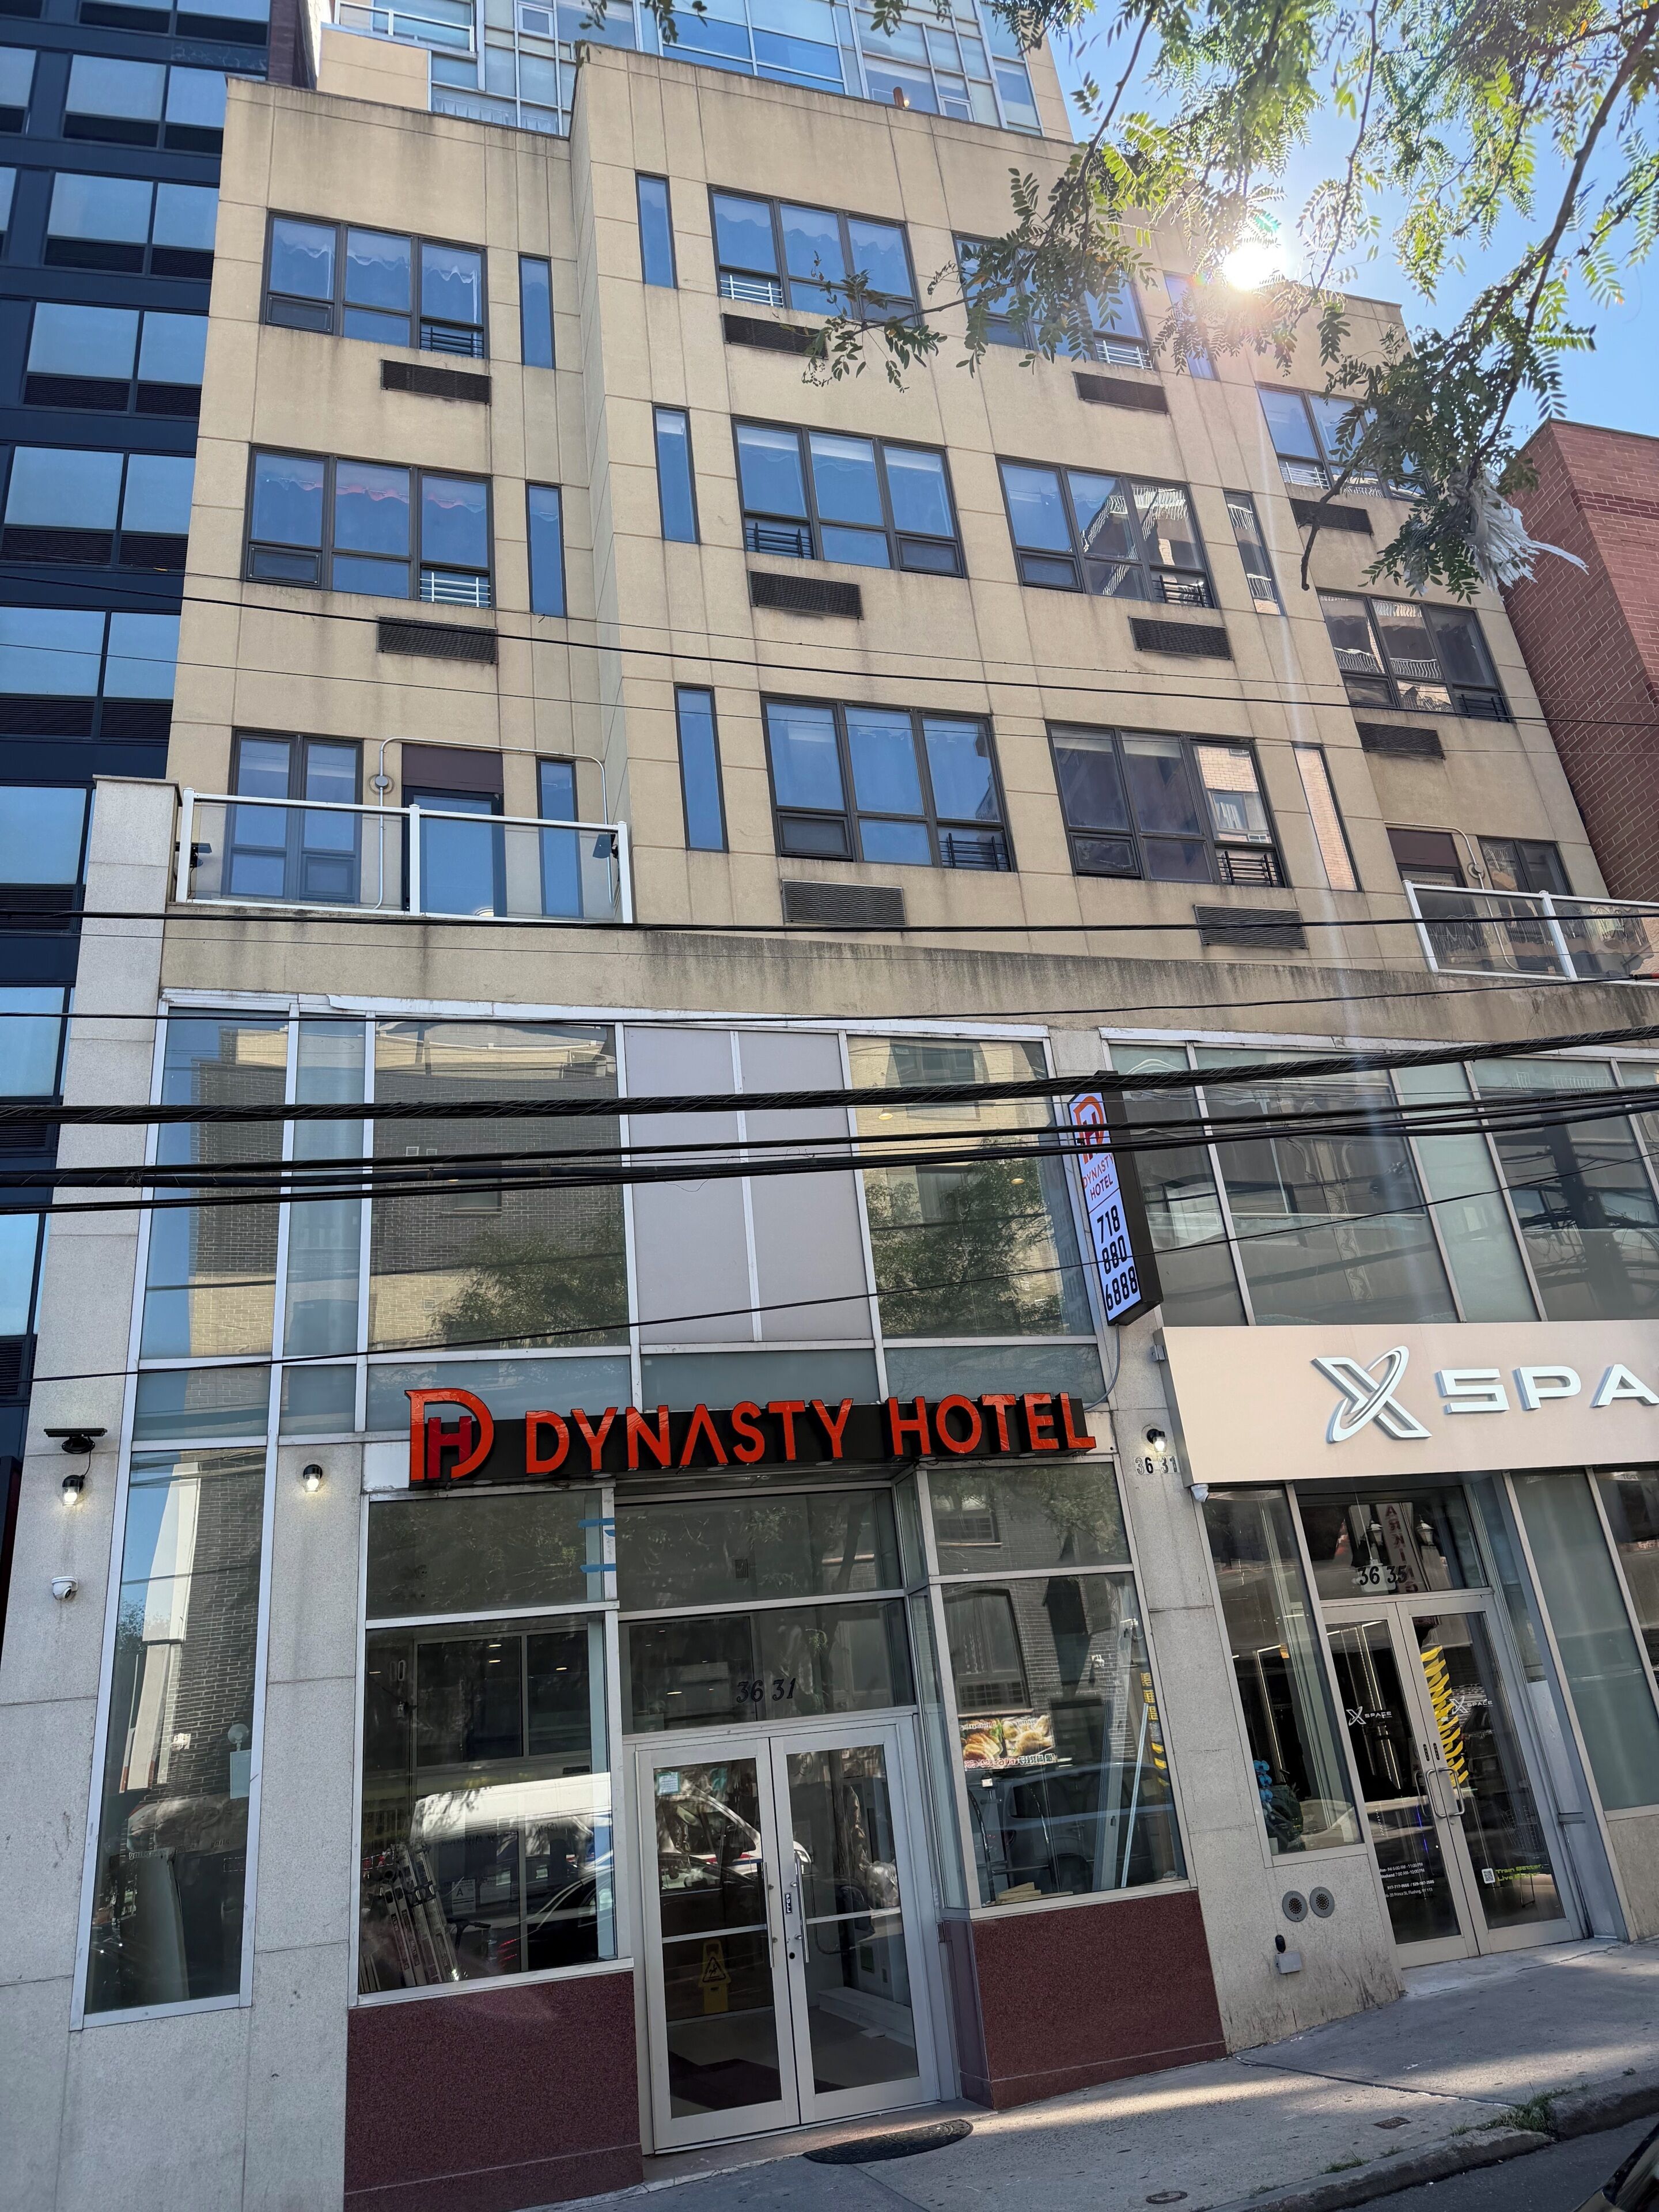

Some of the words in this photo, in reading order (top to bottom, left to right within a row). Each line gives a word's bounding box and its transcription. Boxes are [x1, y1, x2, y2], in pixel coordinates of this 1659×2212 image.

[1082, 1153, 1114, 1190] DYNASTY
[1090, 1173, 1113, 1200] HOTEL
[1097, 1205, 1120, 1244] 718
[1101, 1234, 1128, 1275] 880
[1105, 1266, 1138, 1312] 6888
[1435, 1363, 1659, 1414] SPA
[525, 1397, 854, 1475] DYNASTY
[888, 1391, 1097, 1456] HOTEL
[1467, 1699, 1493, 1707] SPACE
